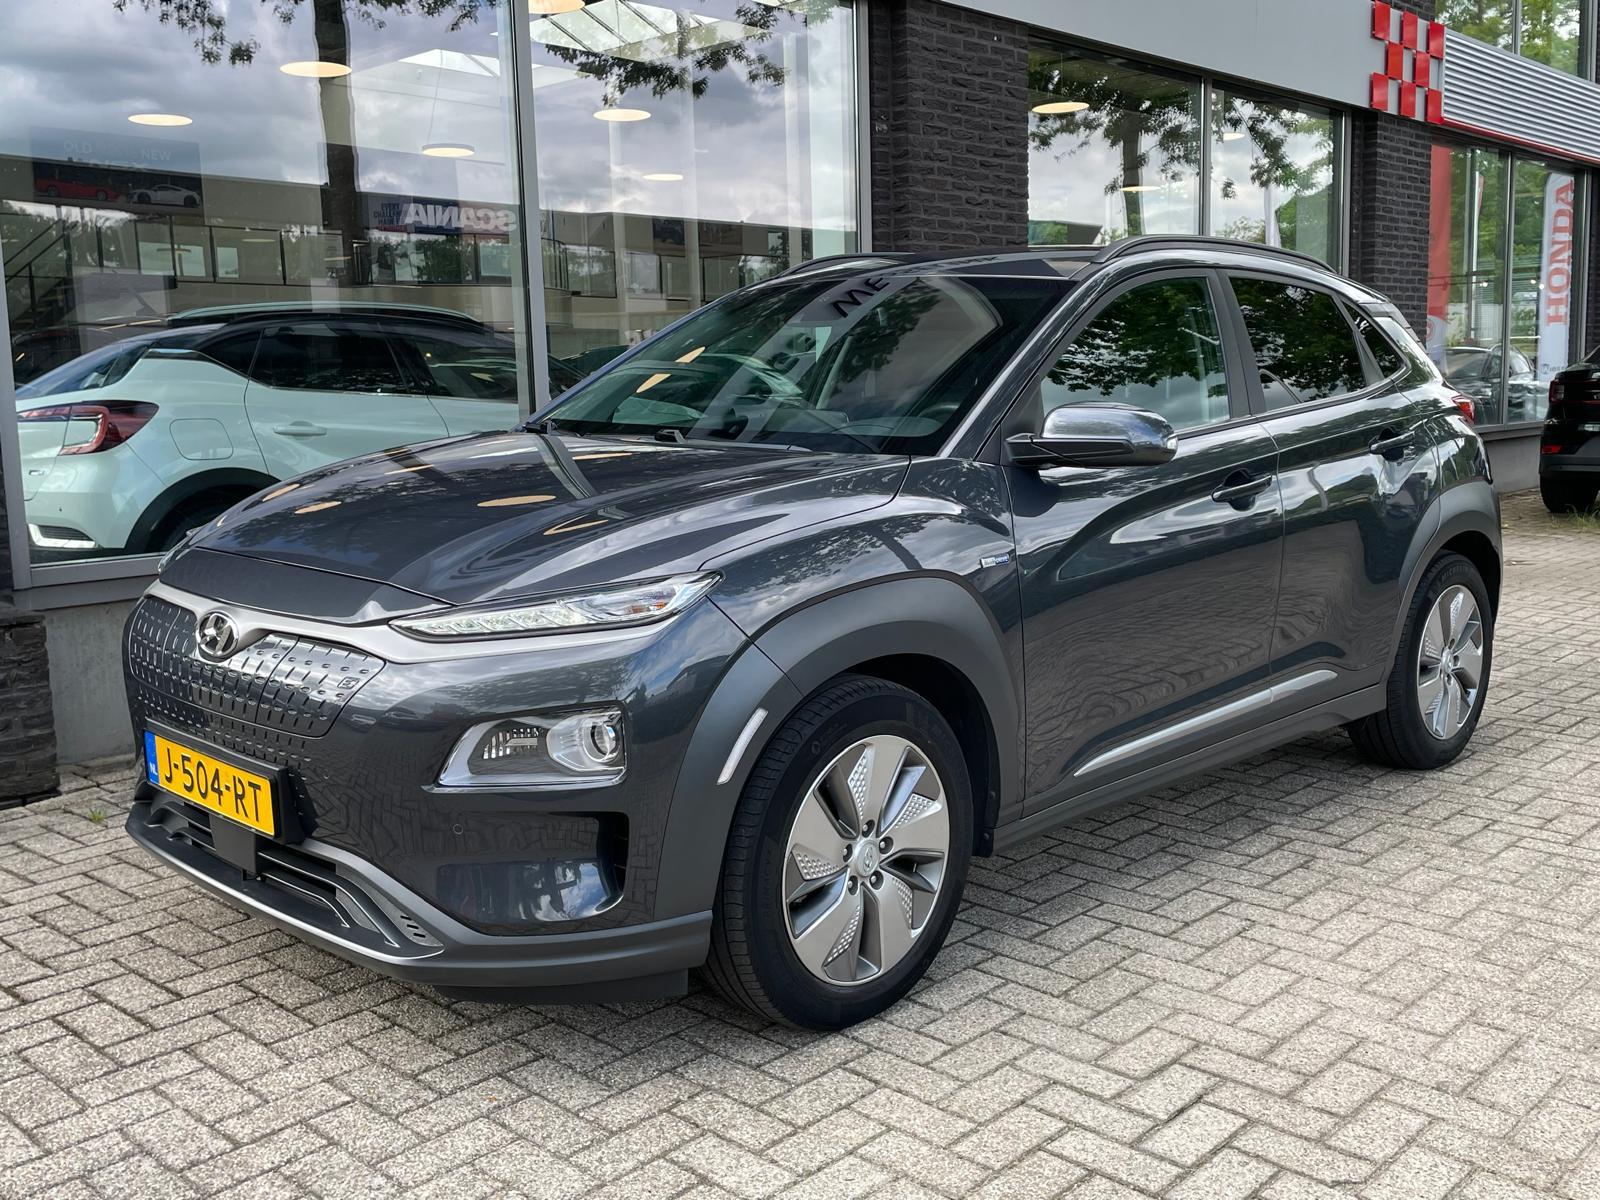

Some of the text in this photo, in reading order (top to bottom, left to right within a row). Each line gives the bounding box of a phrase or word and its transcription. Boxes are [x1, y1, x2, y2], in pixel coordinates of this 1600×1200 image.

[1545, 179, 1574, 326] HONDA
[149, 762, 158, 776] NL
[165, 746, 261, 822] J-504-RT
